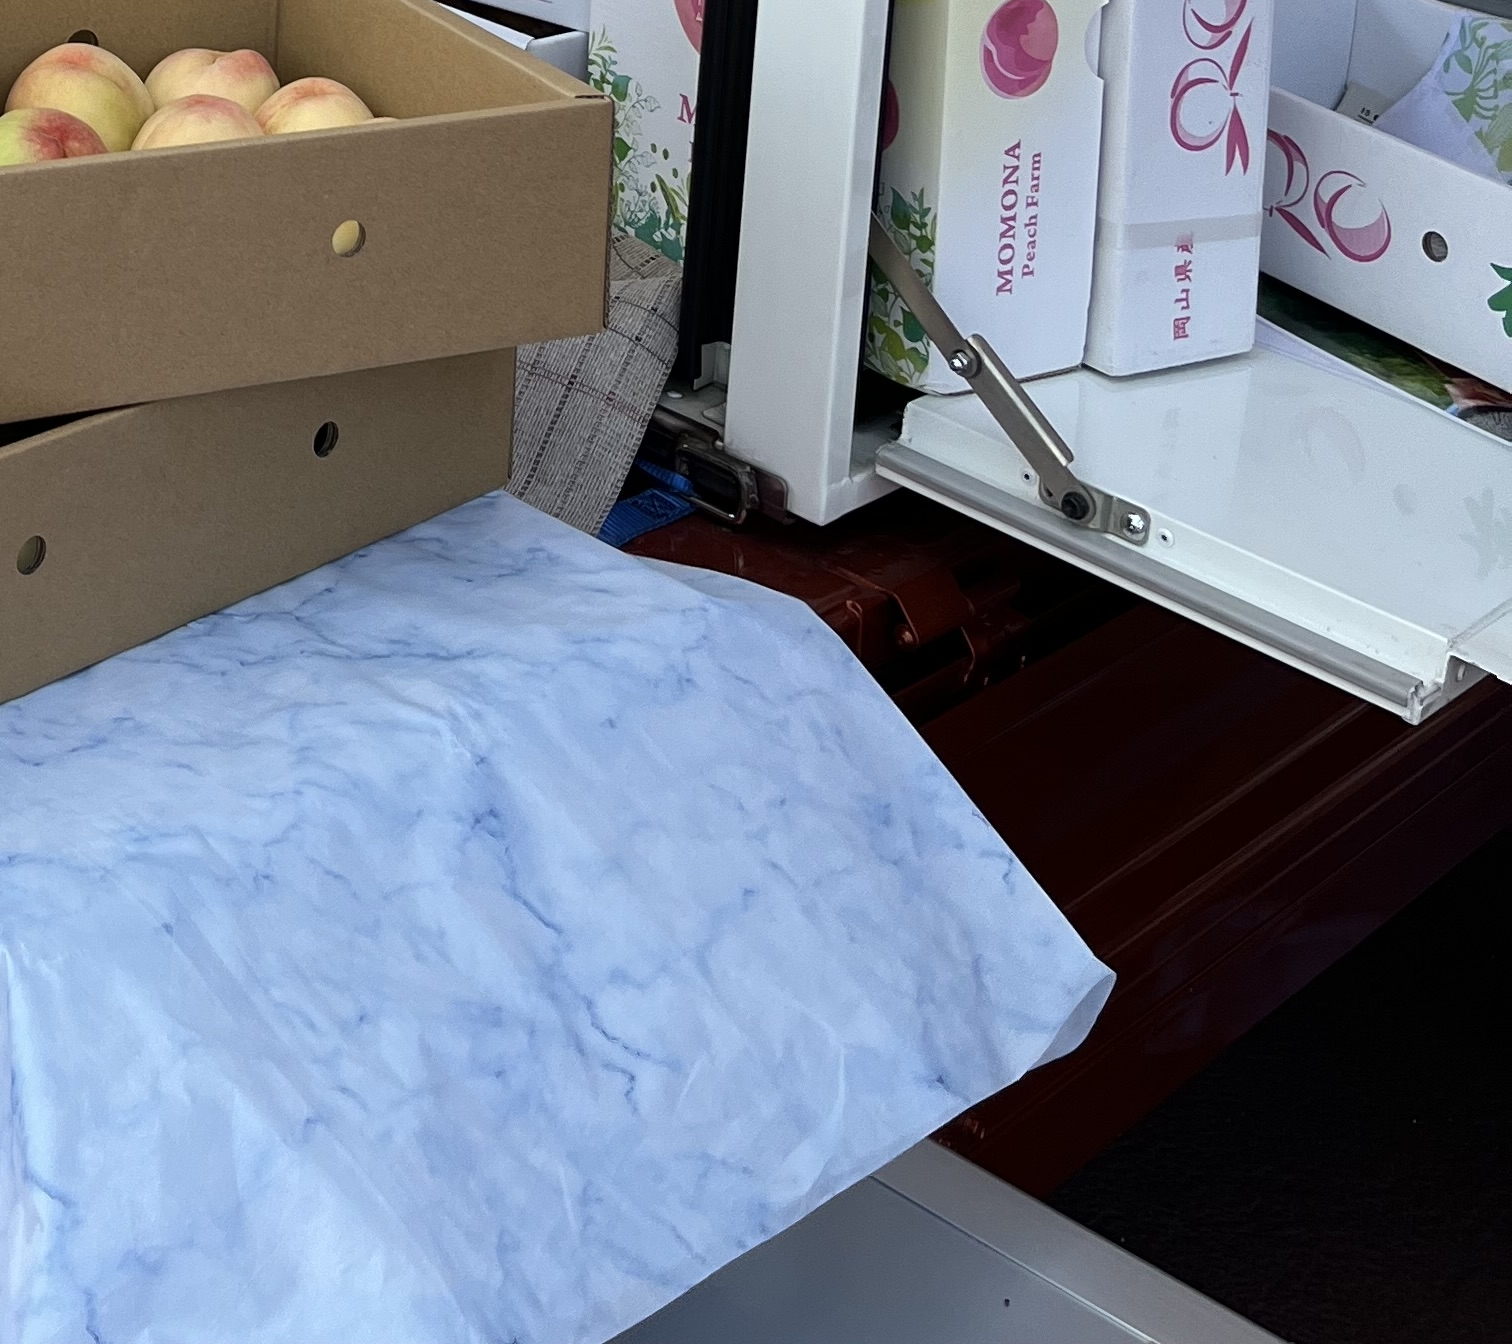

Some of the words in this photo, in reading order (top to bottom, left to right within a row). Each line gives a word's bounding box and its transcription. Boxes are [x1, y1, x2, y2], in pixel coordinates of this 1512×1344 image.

[1025, 151, 1043, 210] Farm
[996, 139, 1022, 297] MOMONA
[1021, 214, 1039, 279] Peach
